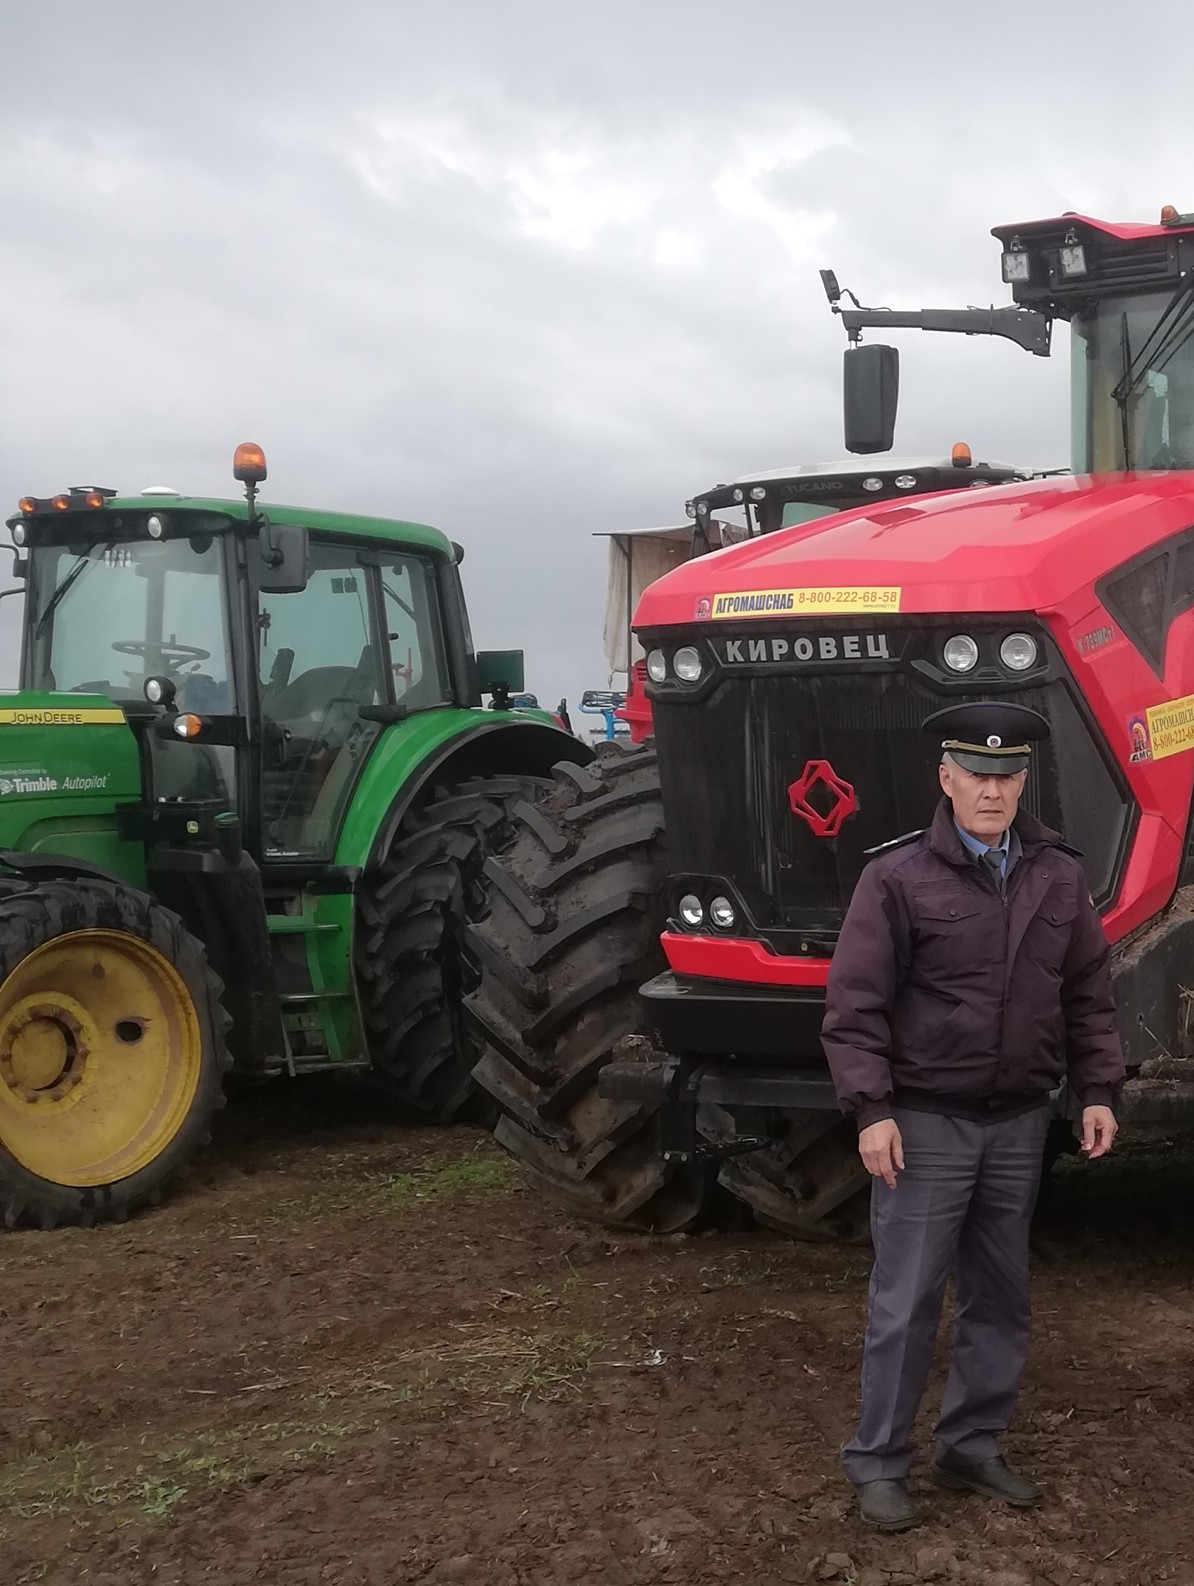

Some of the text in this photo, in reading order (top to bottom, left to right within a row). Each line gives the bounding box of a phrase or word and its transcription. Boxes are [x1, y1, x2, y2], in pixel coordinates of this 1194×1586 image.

[785, 481, 843, 493] TUCANO
[715, 591, 898, 614] АГРОМАШСНАБ 8-800-222-68-58
[726, 634, 890, 662] КИРОВЕЦ
[11, 711, 83, 723] JOHN DEERE
[13, 775, 107, 793] Trimble Autopilot
